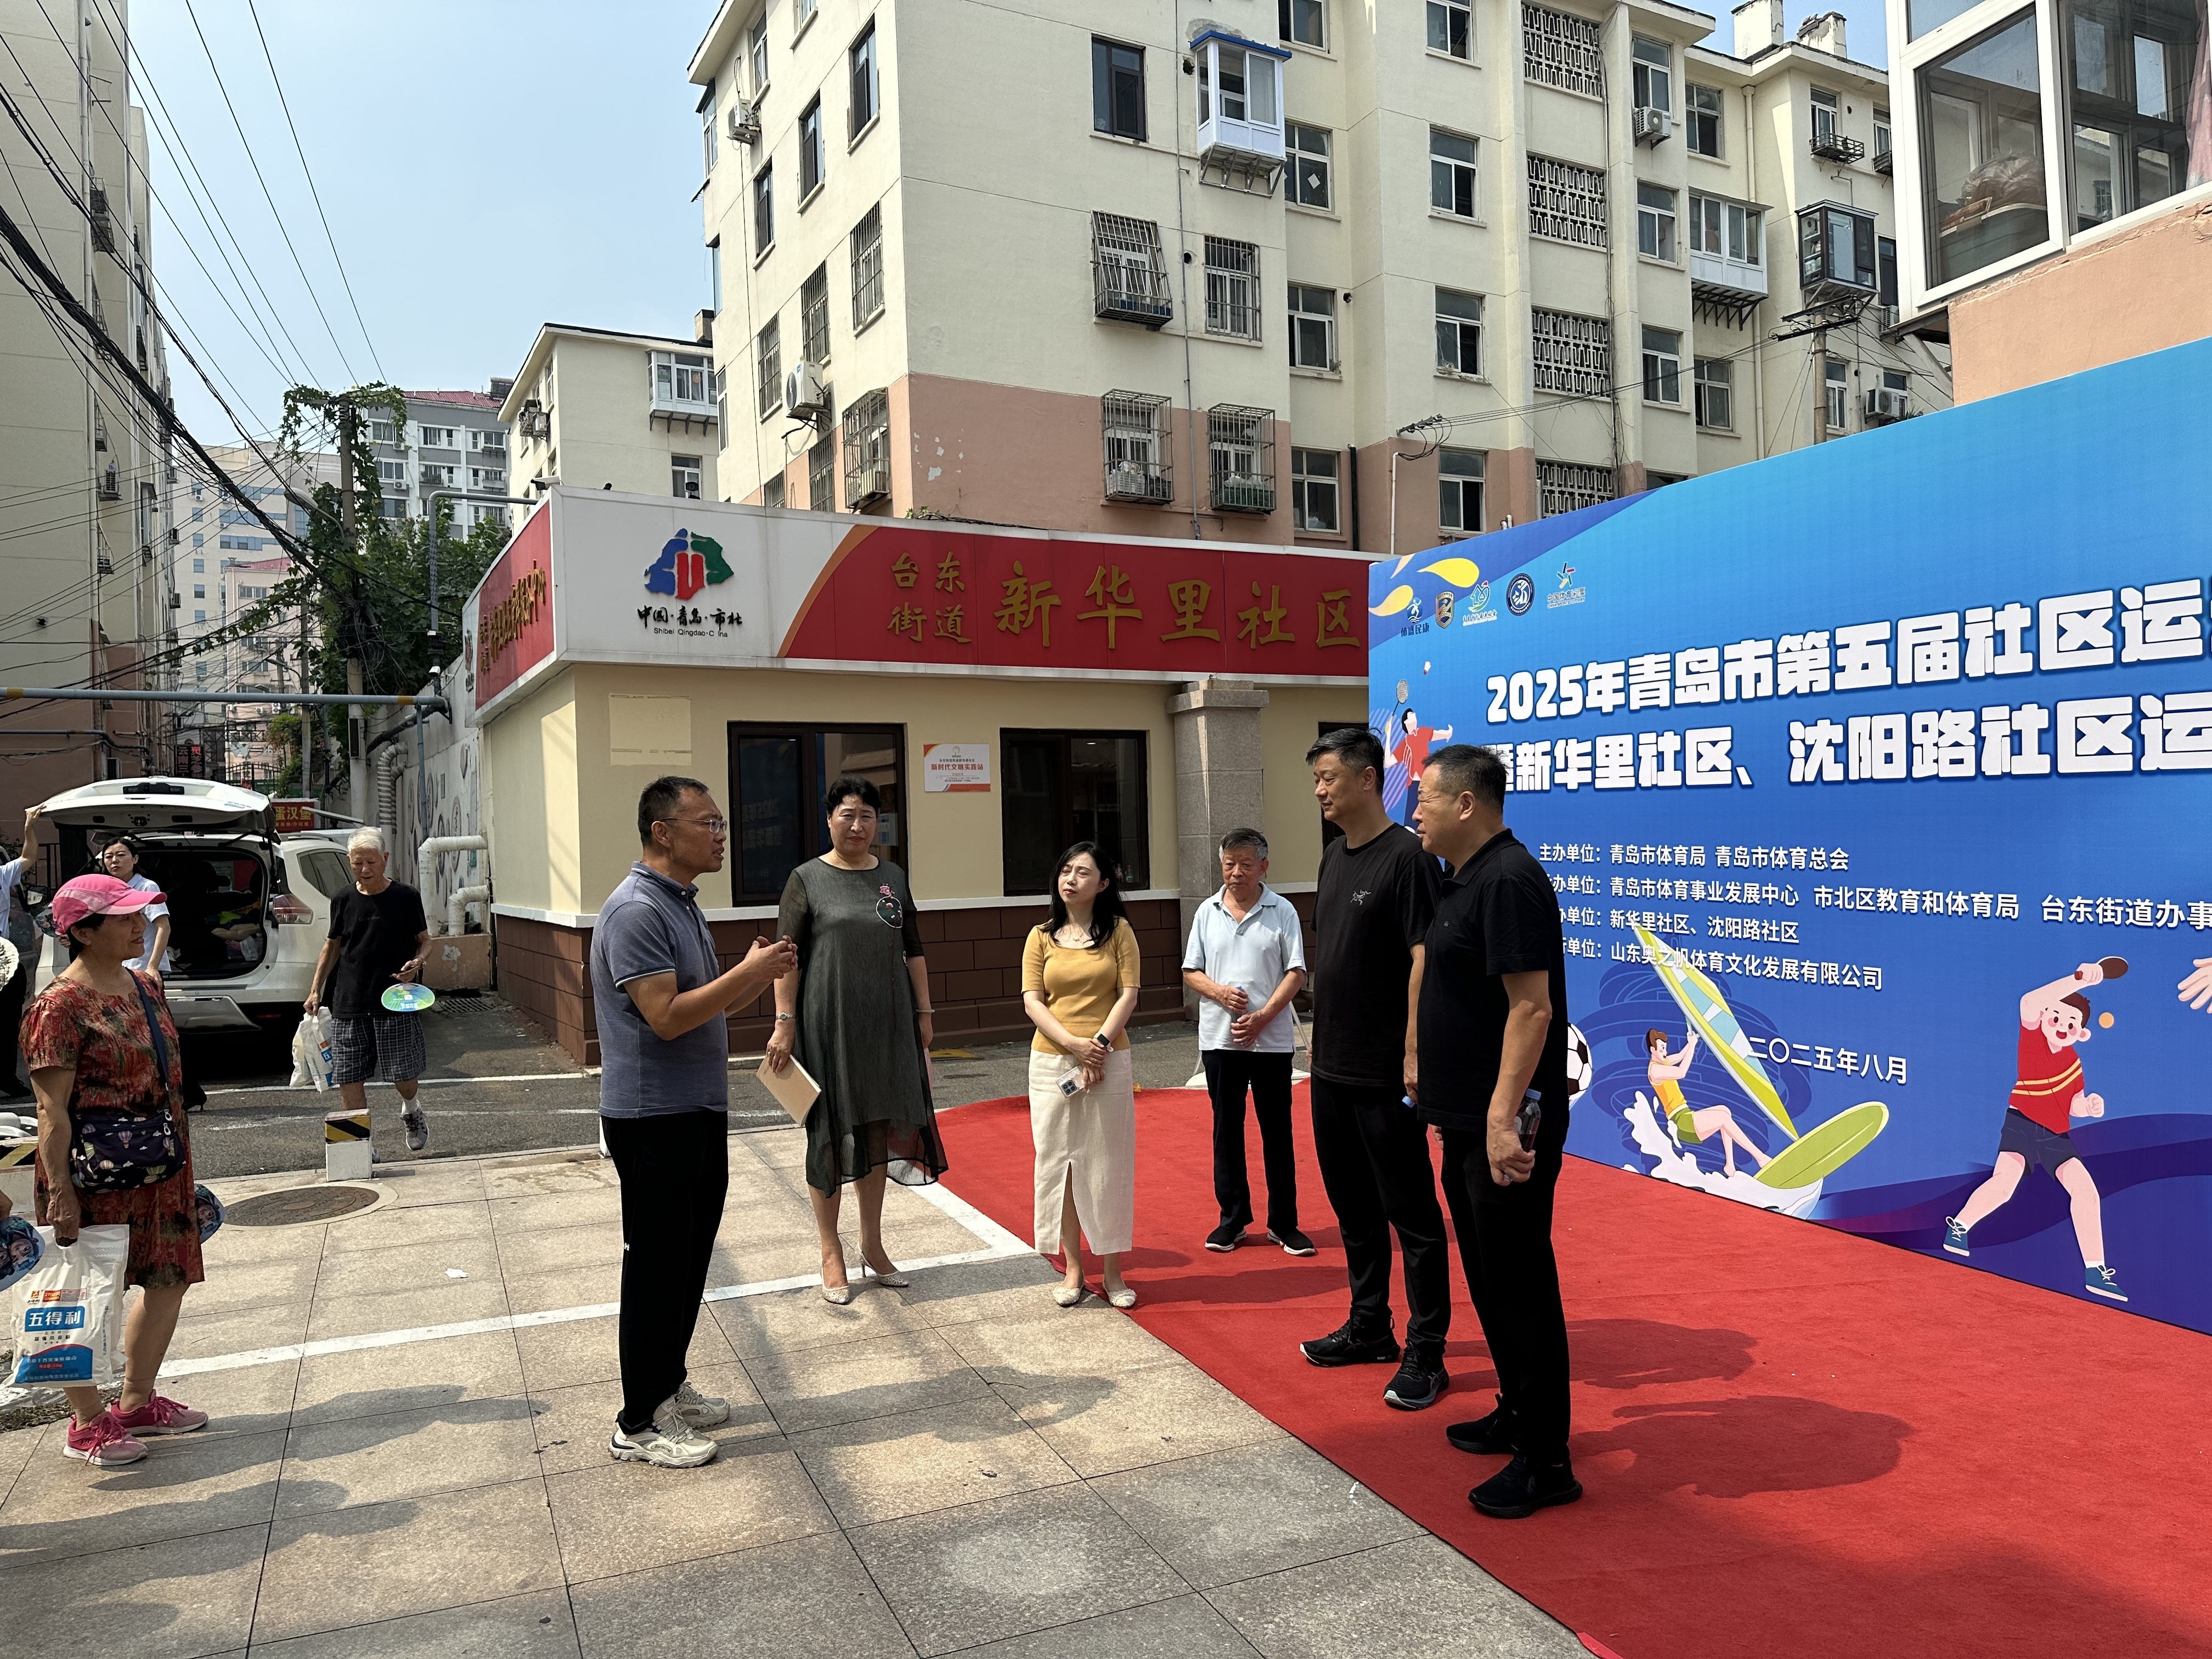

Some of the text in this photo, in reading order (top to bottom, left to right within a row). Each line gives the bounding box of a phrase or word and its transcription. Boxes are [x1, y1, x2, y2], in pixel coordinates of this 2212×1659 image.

[890, 551, 966, 593] 台东
[887, 602, 972, 644] 街道
[994, 560, 1360, 650] 新华里社区
[1487, 579, 2212, 724] 2025年青岛市第五届社区运
[1715, 845, 1849, 871] 青岛市体育总会
[1814, 885, 2019, 919] 市北区教育和体育局
[2041, 894, 2212, 930] 台东街道办事
[28, 1310, 81, 1327] 五得利
